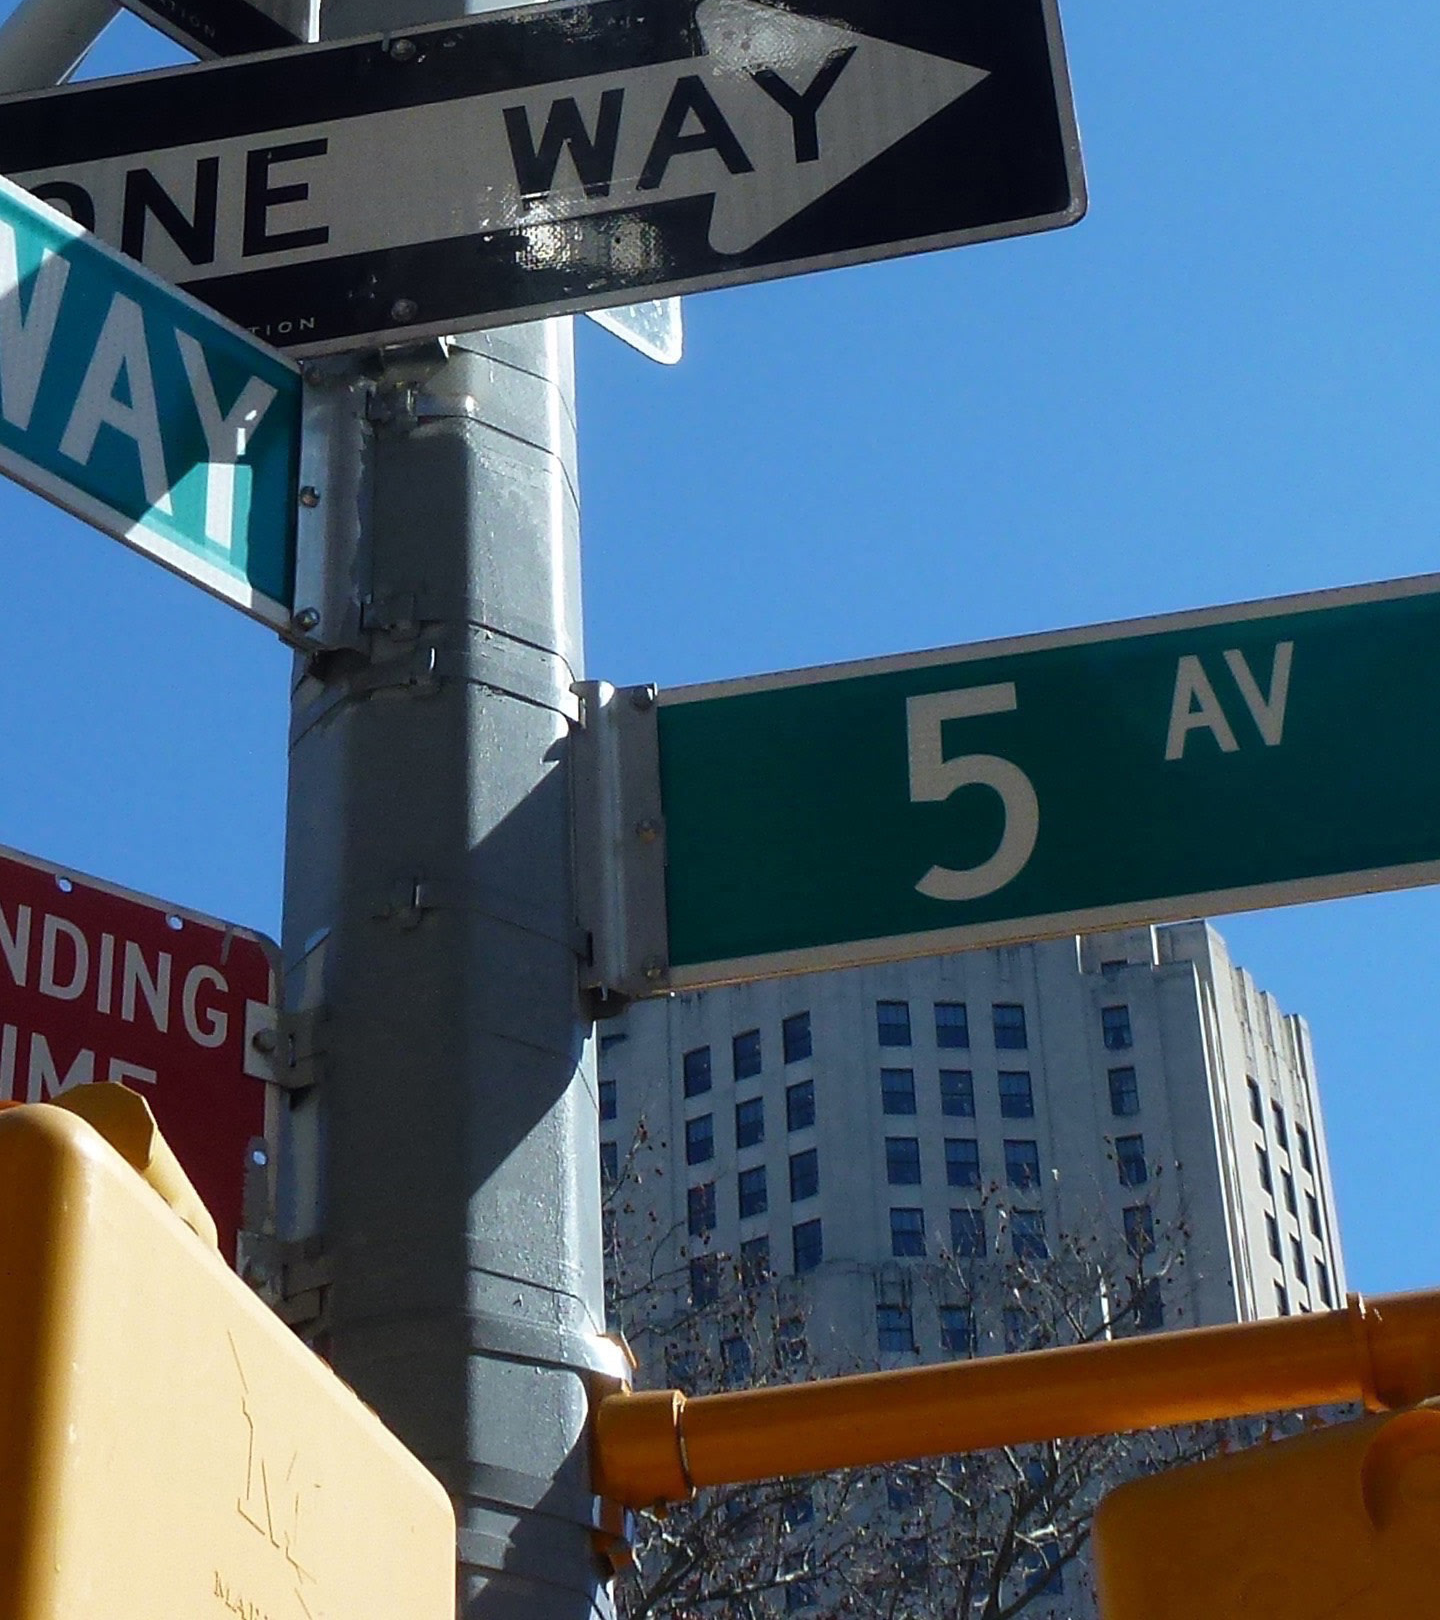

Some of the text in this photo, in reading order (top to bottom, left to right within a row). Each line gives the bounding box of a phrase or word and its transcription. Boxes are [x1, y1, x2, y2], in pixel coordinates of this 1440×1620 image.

[503, 46, 856, 213] WAY
[905, 641, 1293, 902] 5 AV
